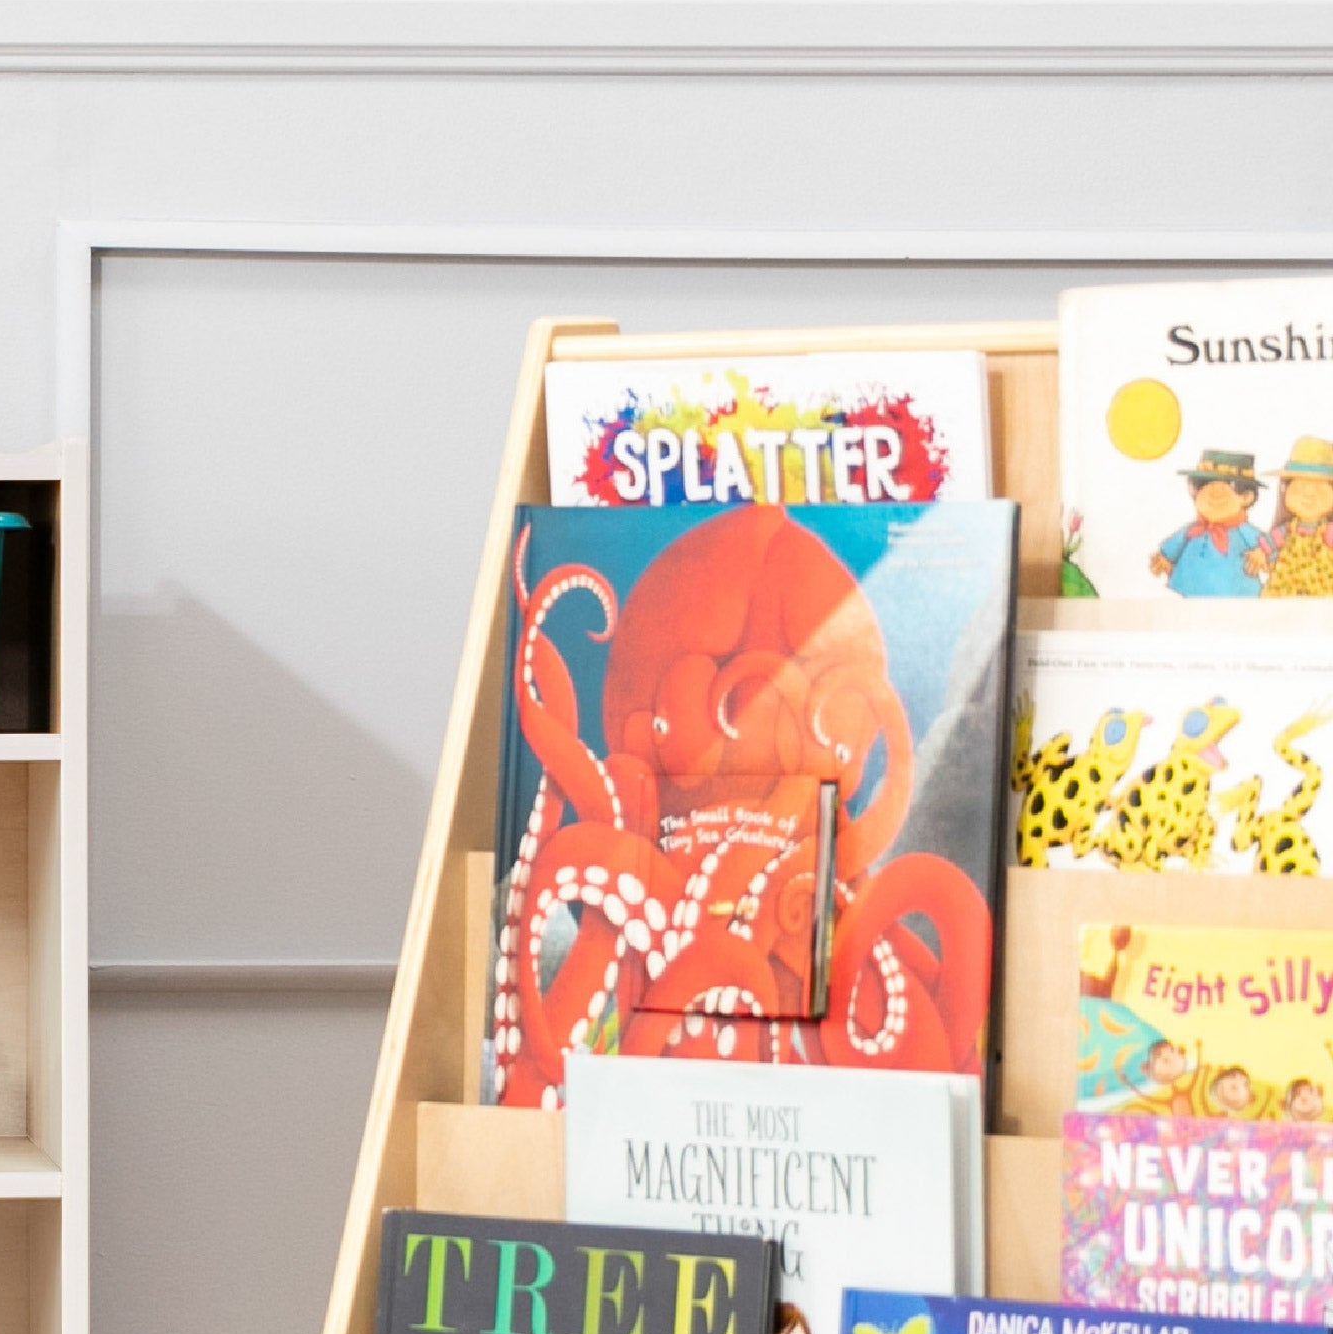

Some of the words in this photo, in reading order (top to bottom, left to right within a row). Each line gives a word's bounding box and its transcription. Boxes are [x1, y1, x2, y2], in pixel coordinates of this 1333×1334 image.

[1165, 322, 1333, 366] Sunshi
[613, 427, 911, 503] SPLATTER
[778, 816, 796, 835] of
[1143, 962, 1225, 1014] Eight
[691, 1100, 735, 1139] THE
[746, 1104, 802, 1142] MOST
[623, 1139, 877, 1216] MAGNIFICENT
[1099, 1140, 1268, 1199] NEVER
